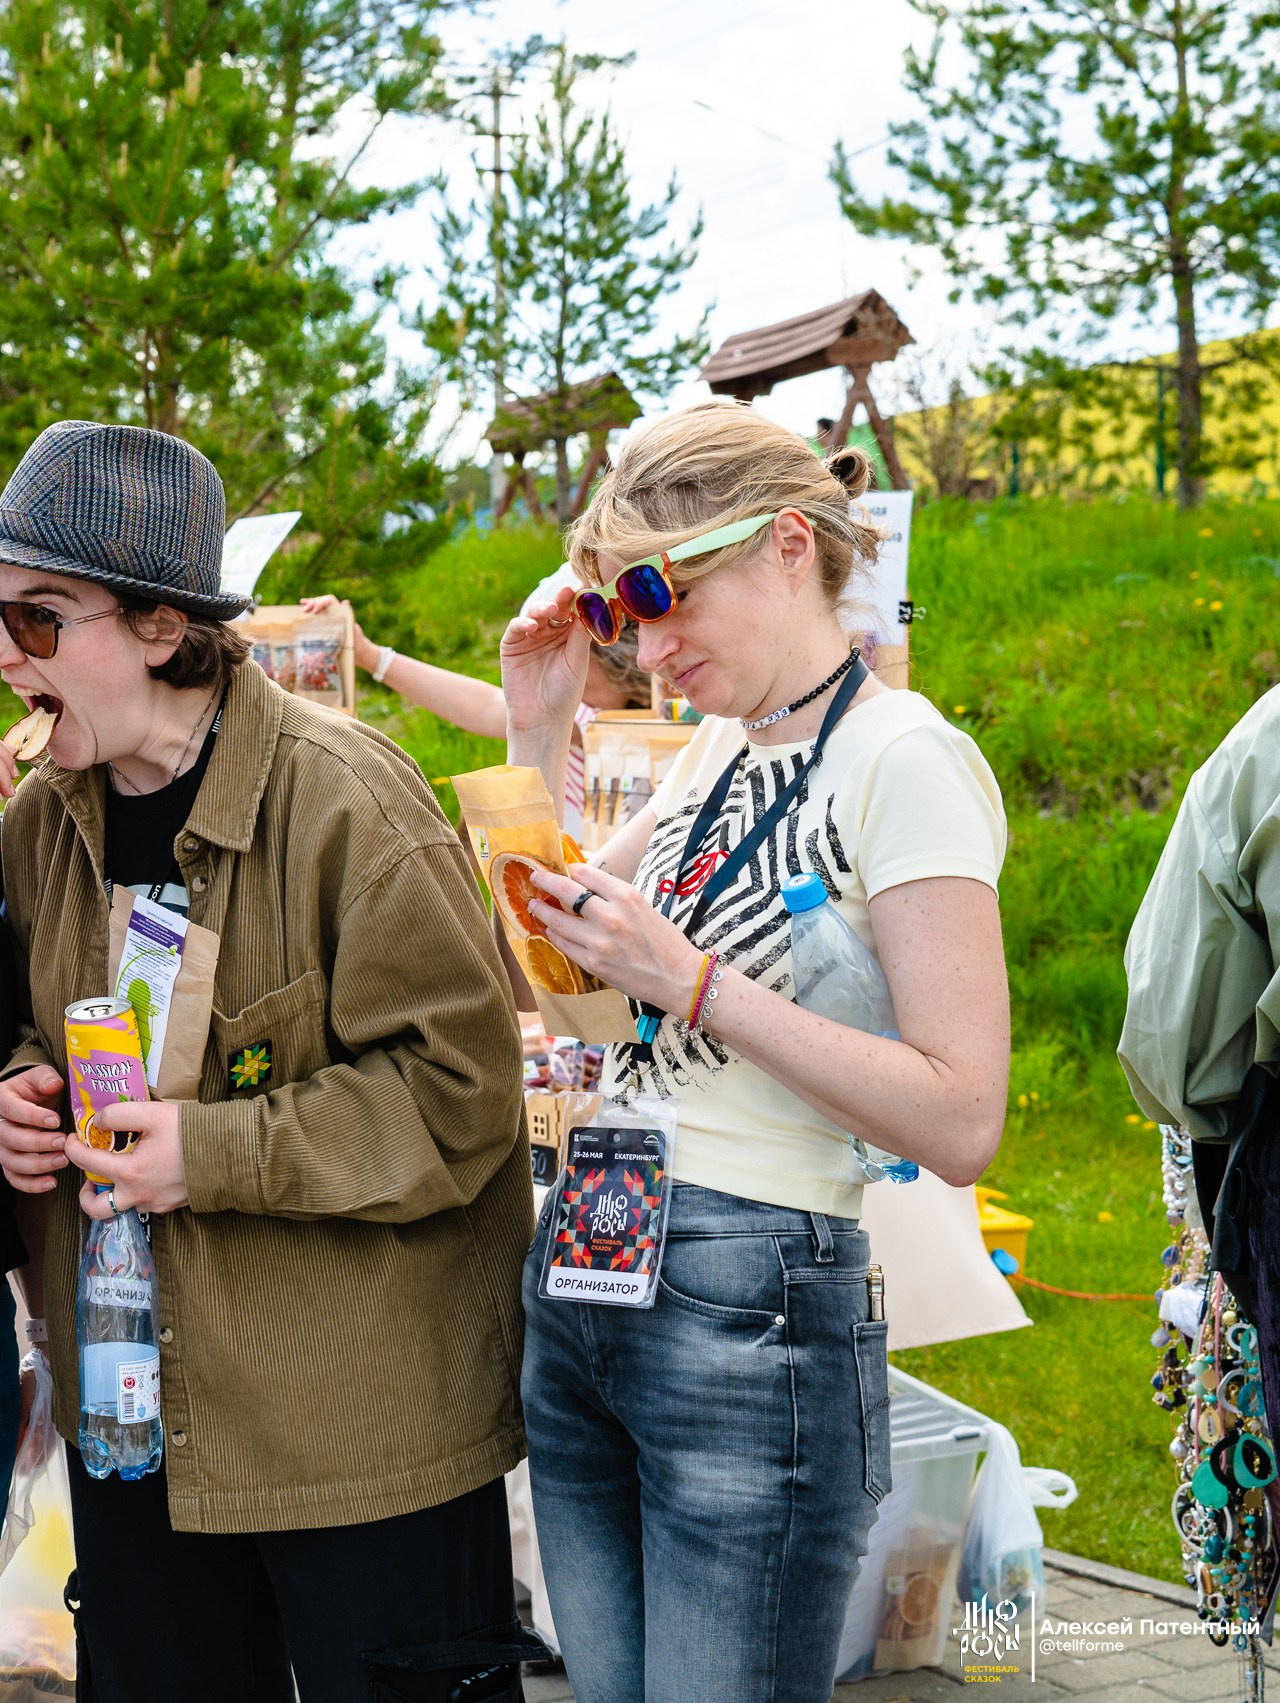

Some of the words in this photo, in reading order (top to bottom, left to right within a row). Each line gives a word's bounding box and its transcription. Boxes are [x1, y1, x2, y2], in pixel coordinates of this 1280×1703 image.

[80, 1060, 133, 1078] PASSION
[91, 1078, 130, 1093] FRUIT
[589, 1151, 603, 1159] МАЯ
[614, 1152, 660, 1162] ЕКАТЕРИНБУРГ
[592, 1238, 623, 1246] ФЕСТИВАЛЬ
[590, 1244, 613, 1252] СКАЗОК
[555, 1277, 639, 1295] ОРГАНИЗАТОР
